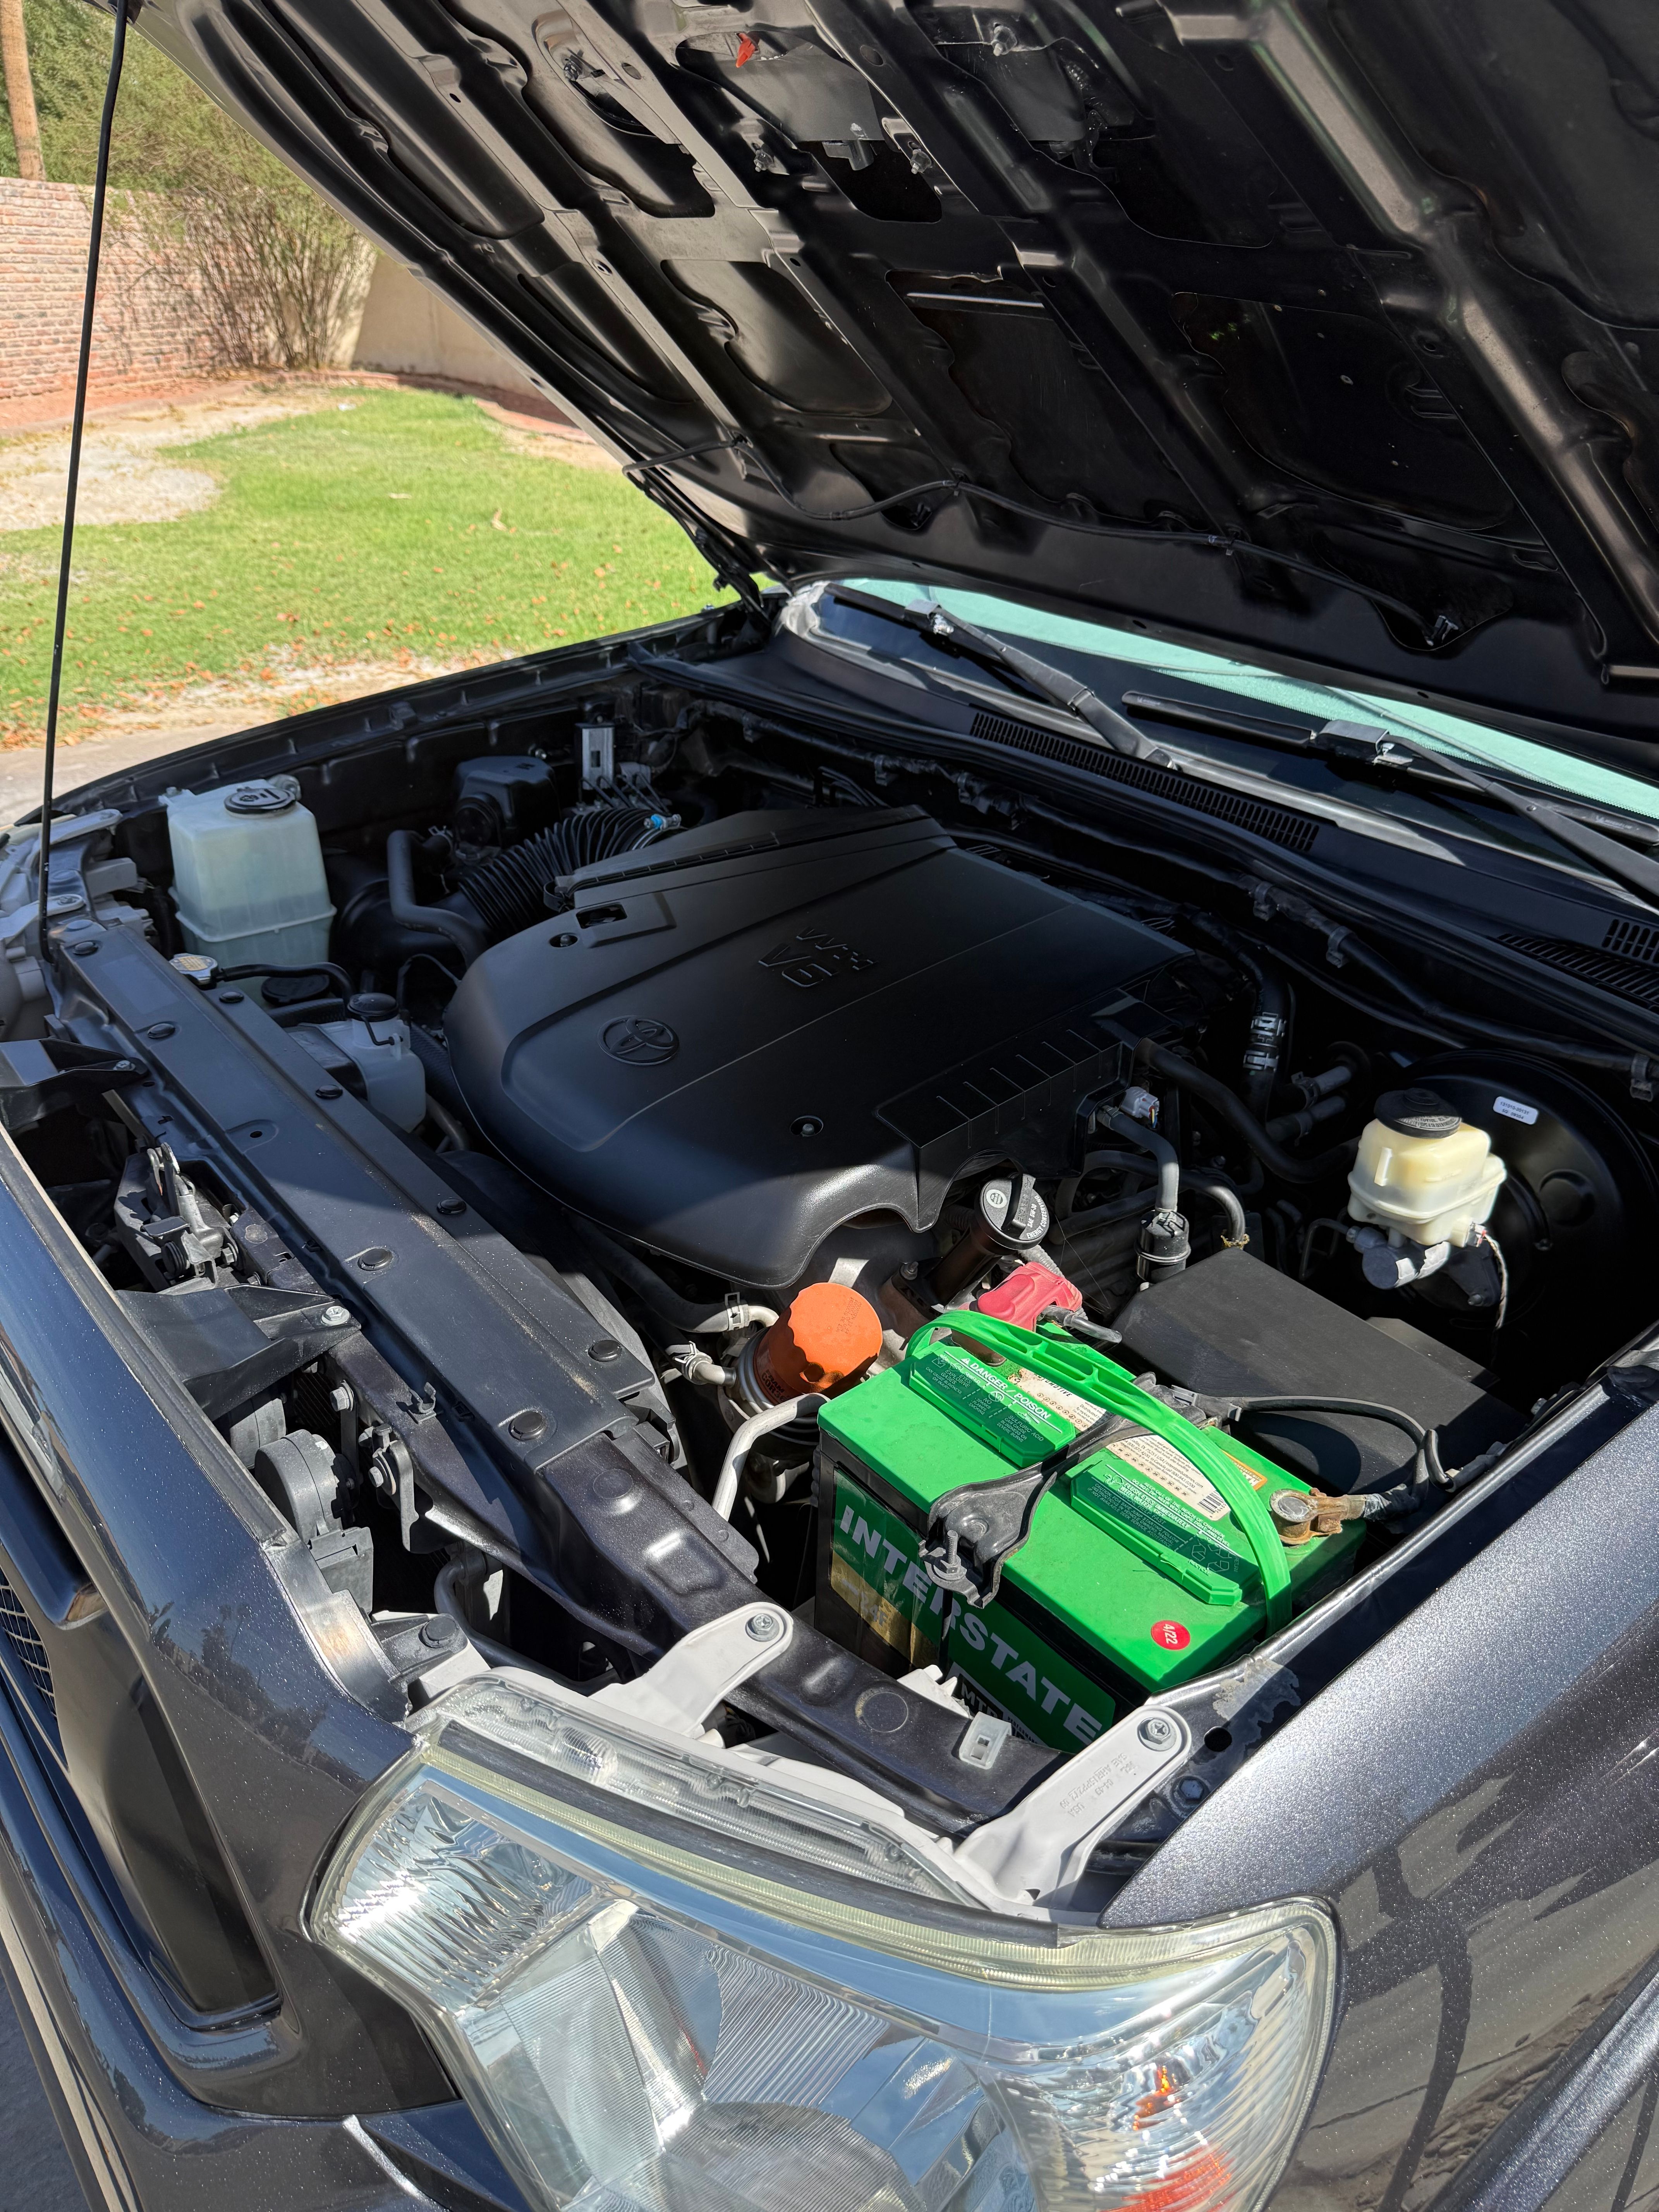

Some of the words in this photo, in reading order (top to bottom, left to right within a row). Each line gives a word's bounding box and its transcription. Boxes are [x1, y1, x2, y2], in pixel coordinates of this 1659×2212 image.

[758, 943, 837, 988] V6
[1035, 1195, 1048, 1228] CONSERVING
[1027, 1225, 1044, 1239] ENERGY
[765, 1369, 785, 1393] FRAM
[933, 1372, 944, 1381] CAUSE
[944, 1379, 962, 1394] BLINDNESS
[941, 1372, 957, 1385] GASES
[945, 1370, 970, 1388] EXPLOSIVE
[960, 1374, 972, 1384] EYES
[969, 1362, 1008, 1391] DANGER
[1014, 1393, 1051, 1419] POISON
[969, 1403, 985, 1415] SMOKING
[972, 1400, 986, 1412] FLAMES
[976, 1398, 991, 1409] SPARKS
[997, 1423, 1011, 1434] SEVERE
[1010, 1431, 1024, 1442] BURNS
[1001, 1420, 1022, 1437] BLINDNESS
[1008, 1415, 1032, 1433] SULFURIC
[1031, 1432, 1044, 1441] ACID
[1013, 1424, 1027, 1434] CAUSE
[1091, 1486, 1119, 1506] INSTRUCTIONS
[1124, 1507, 1141, 1521] VEHICLE
[1117, 1490, 1136, 1505] MEDICAL
[1137, 1504, 1152, 1515] HELP
[1151, 1513, 1166, 1525] FAST
[1119, 1486, 1134, 1497] WITH
[1133, 1495, 1152, 1509] WATER
[1153, 1508, 1165, 1518] GET
[1123, 1483, 1141, 1496] FLUSH
[1140, 1494, 1155, 1505] EYES
[1155, 1504, 1190, 1528] IMMEDIATELY
[1143, 1482, 1156, 1491] KEEP
[1172, 1501, 1181, 1509] THE
[1181, 1507, 1195, 1519] REACH
[1100, 1497, 1121, 1512] AVAILABLE
[1120, 1511, 1132, 1520] SEEK
[1130, 1518, 1148, 1531] SERVICE
[1112, 1495, 1121, 1504] FOR
[1121, 1503, 1132, 1511] SAFE
[1131, 1508, 1143, 1519] JUMP
[1142, 1515, 1163, 1532] STARTING
[1162, 1530, 1180, 1543] FOLLOW
[1157, 1496, 1169, 1506] KEEP
[1169, 1504, 1181, 1514] VENT
[1181, 1512, 1193, 1522] CAPS
[1194, 1520, 1207, 1530] TIGHT
[1206, 1528, 1216, 1537] AND
[1188, 1559, 1212, 1576] RECYCLE
[840, 1504, 1103, 1746] INTERSTATE
[1162, 1623, 1178, 1644] 4/22
[1111, 1752, 1127, 1767] SAE
[1067, 1801, 1086, 1817] USA
